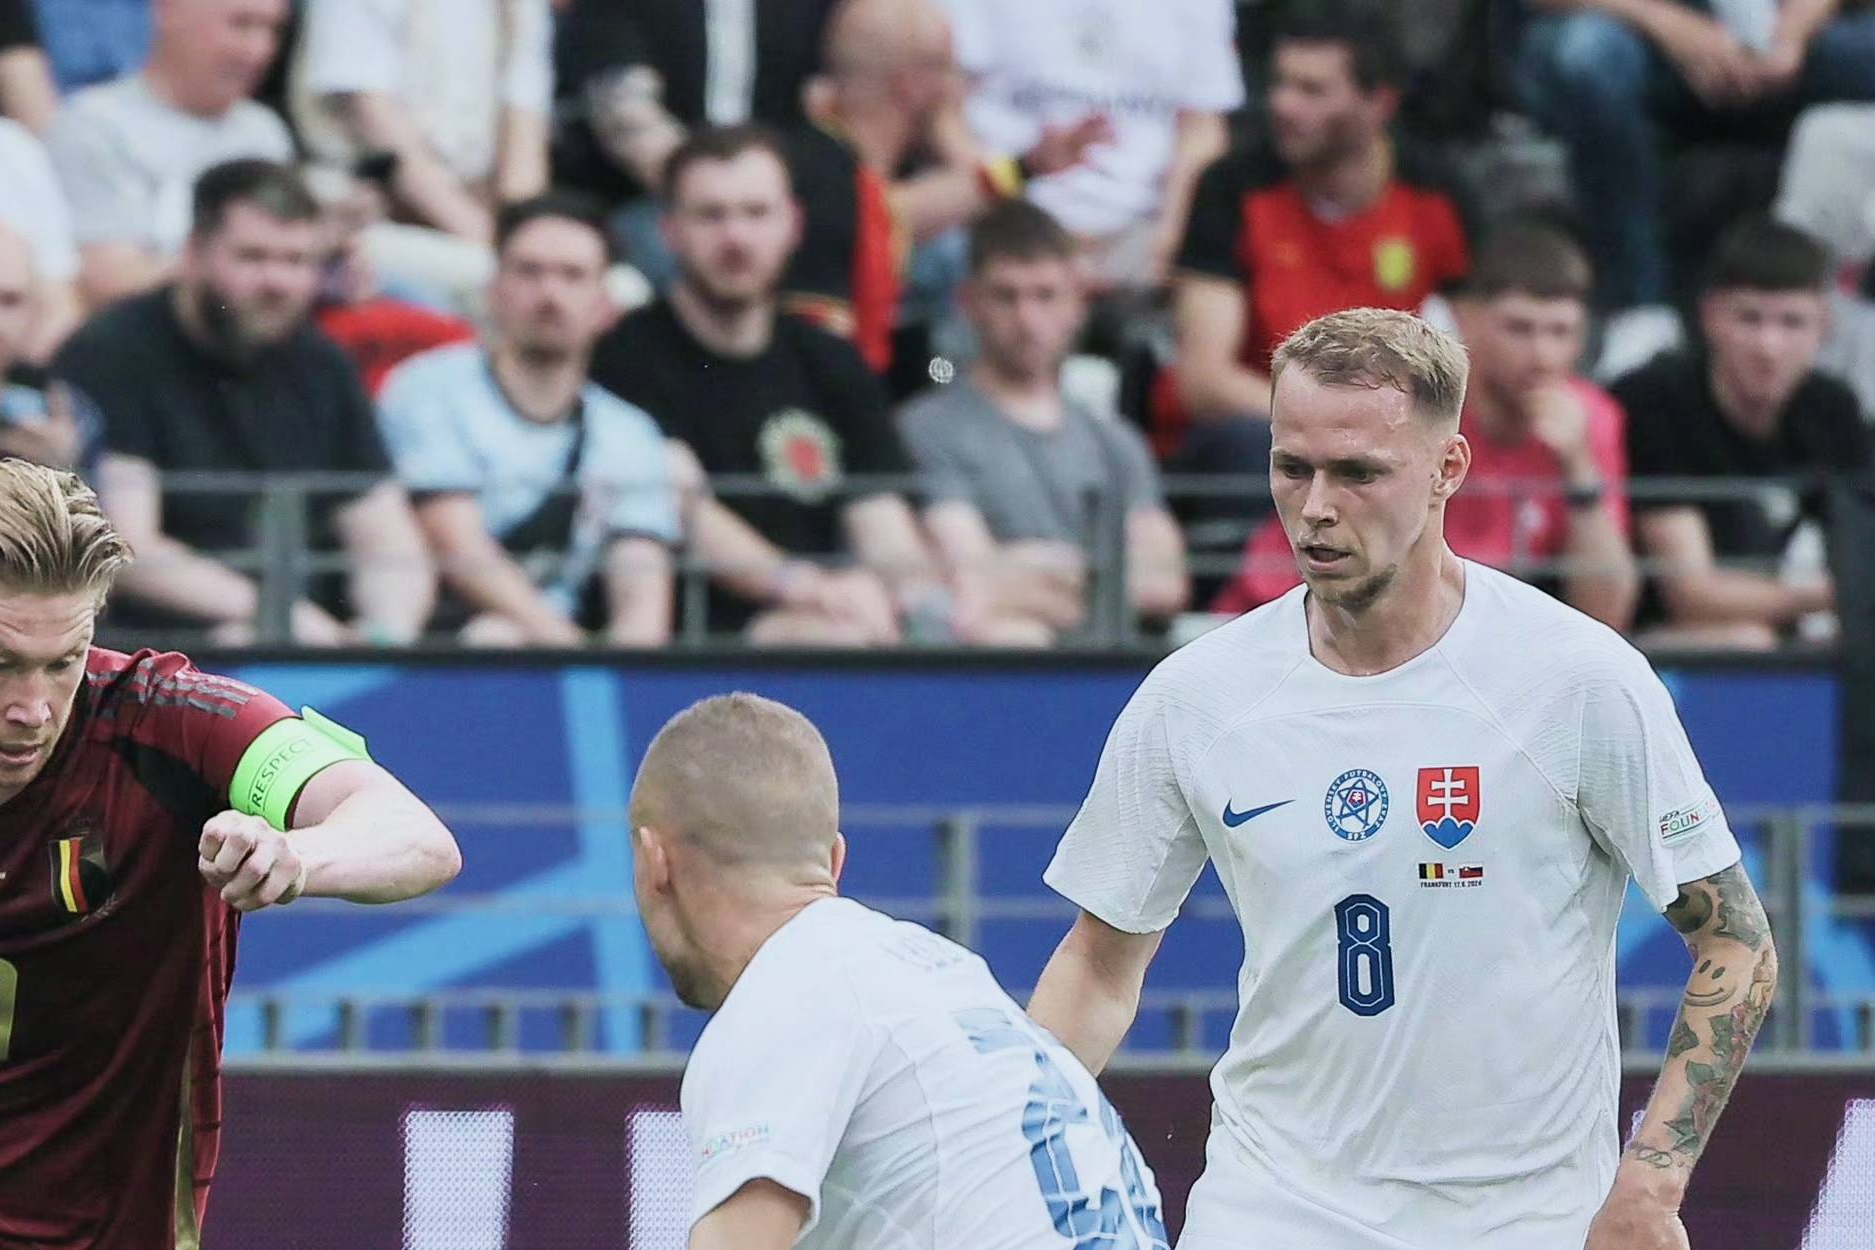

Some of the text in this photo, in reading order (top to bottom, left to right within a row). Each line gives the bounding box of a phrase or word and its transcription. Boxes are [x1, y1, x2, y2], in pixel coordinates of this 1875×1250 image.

[251, 738, 312, 807] RESPECT
[1660, 811, 1701, 836] FOUN
[1420, 881, 1452, 889] FRANKFURT
[1334, 893, 1396, 1017] 8
